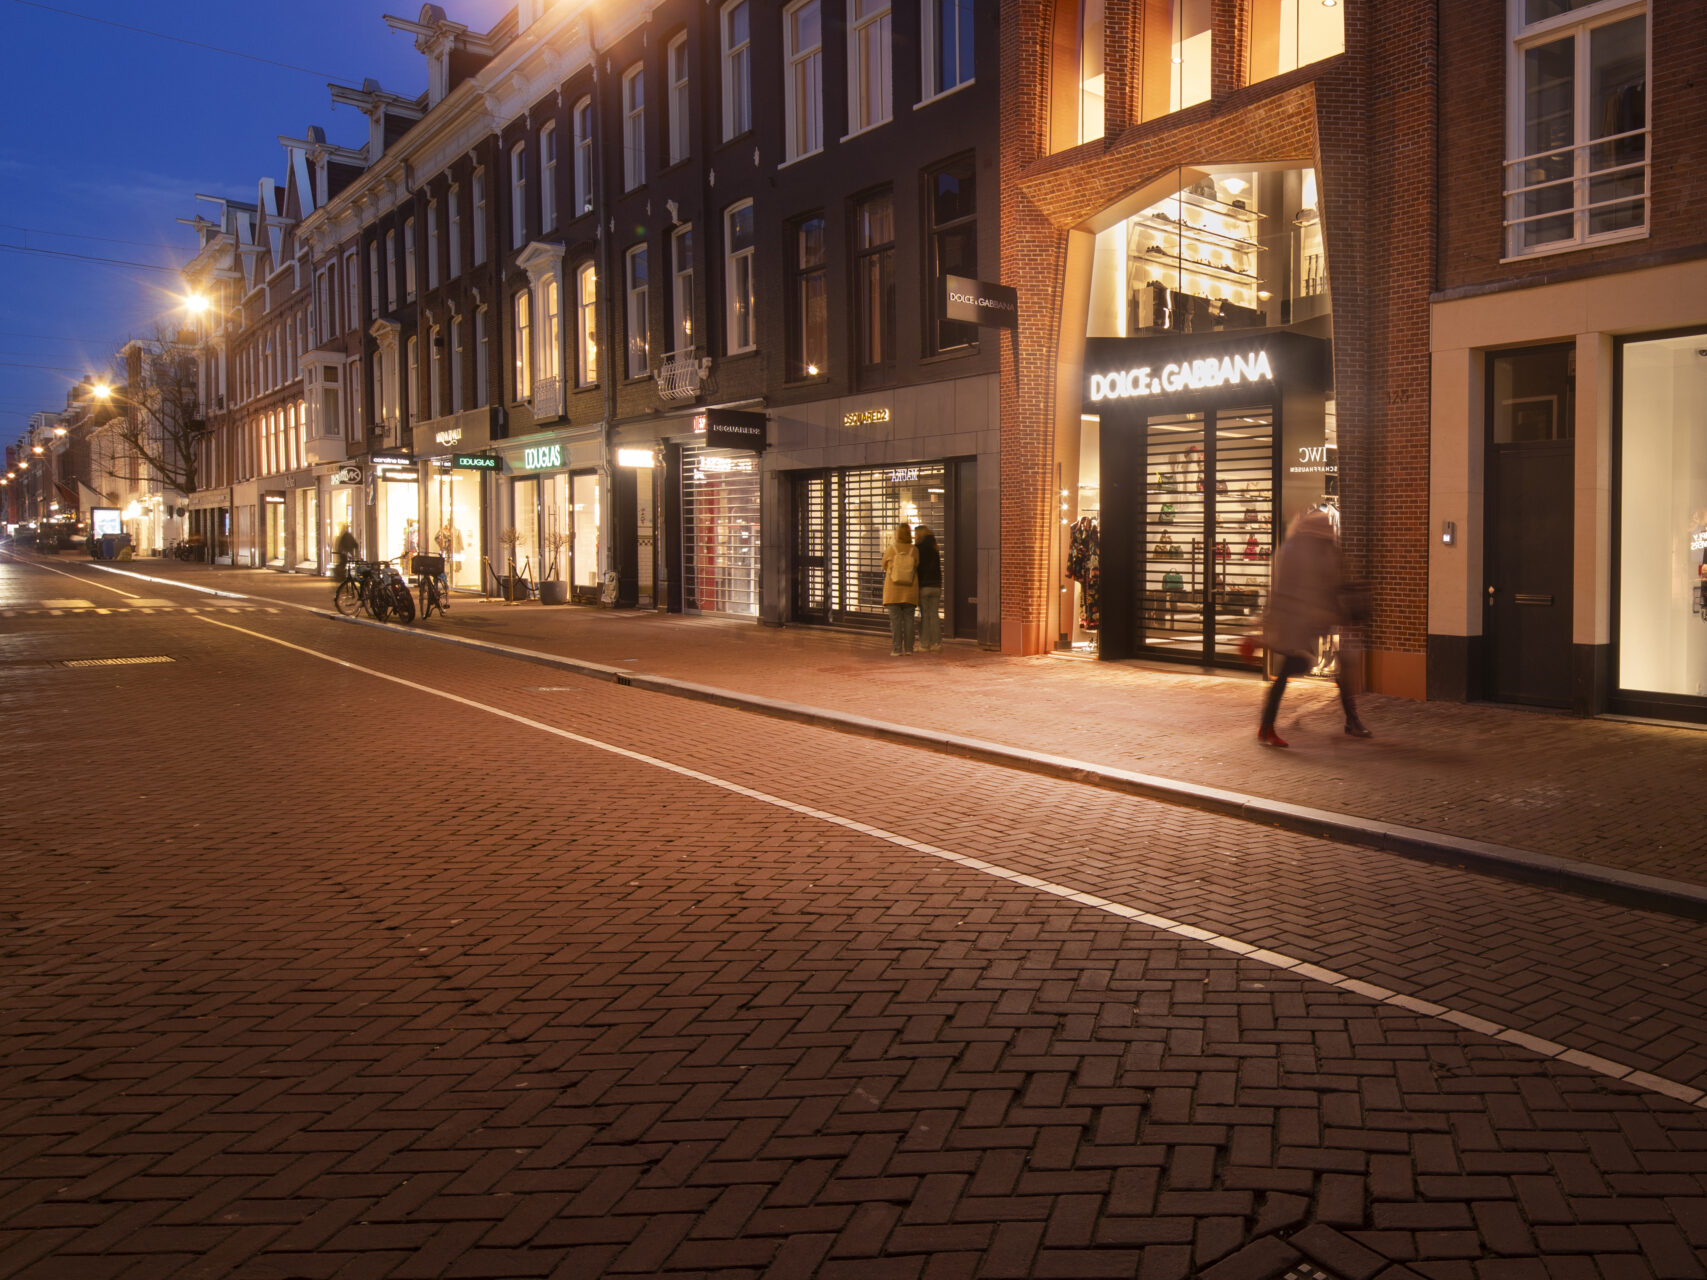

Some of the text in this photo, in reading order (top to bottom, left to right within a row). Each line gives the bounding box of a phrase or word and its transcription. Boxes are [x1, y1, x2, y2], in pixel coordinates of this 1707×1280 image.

[950, 292, 975, 305] DOLCE
[979, 297, 1015, 312] GABBANA
[1090, 367, 1151, 401] DOLCE
[1162, 350, 1273, 392] GABBANA
[843, 408, 890, 426] DSQUARED2
[460, 458, 495, 467] DOUGLAS
[525, 445, 562, 469] DOUGLAS
